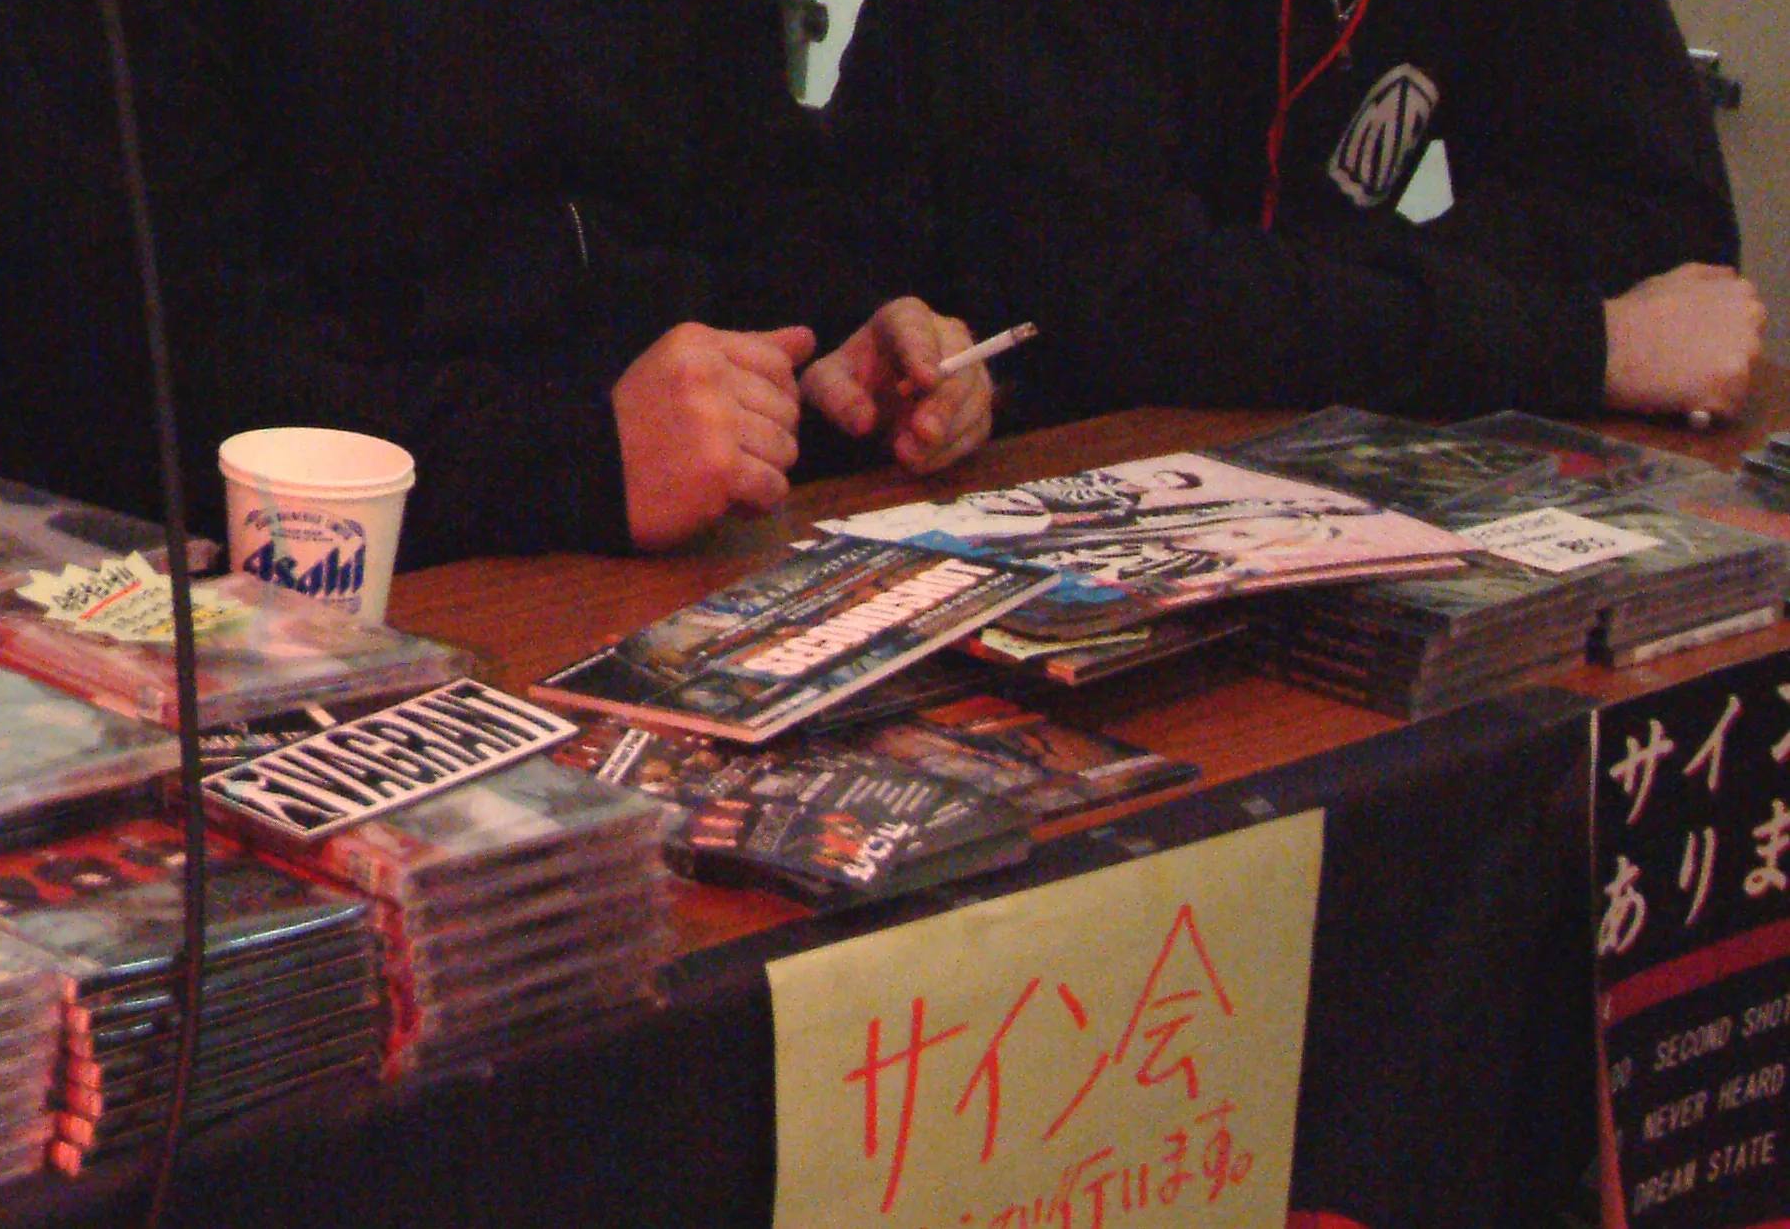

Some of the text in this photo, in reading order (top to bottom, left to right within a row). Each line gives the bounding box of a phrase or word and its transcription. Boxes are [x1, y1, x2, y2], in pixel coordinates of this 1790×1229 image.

[243, 539, 366, 597] Asahi
[279, 682, 560, 808] VAGRANT
[844, 904, 1234, 1214] サイン会
[1652, 1015, 1734, 1072] SECOND
[1643, 1062, 1787, 1140] NEVER HEARD
[1632, 1130, 1778, 1216] DREAM STATE
